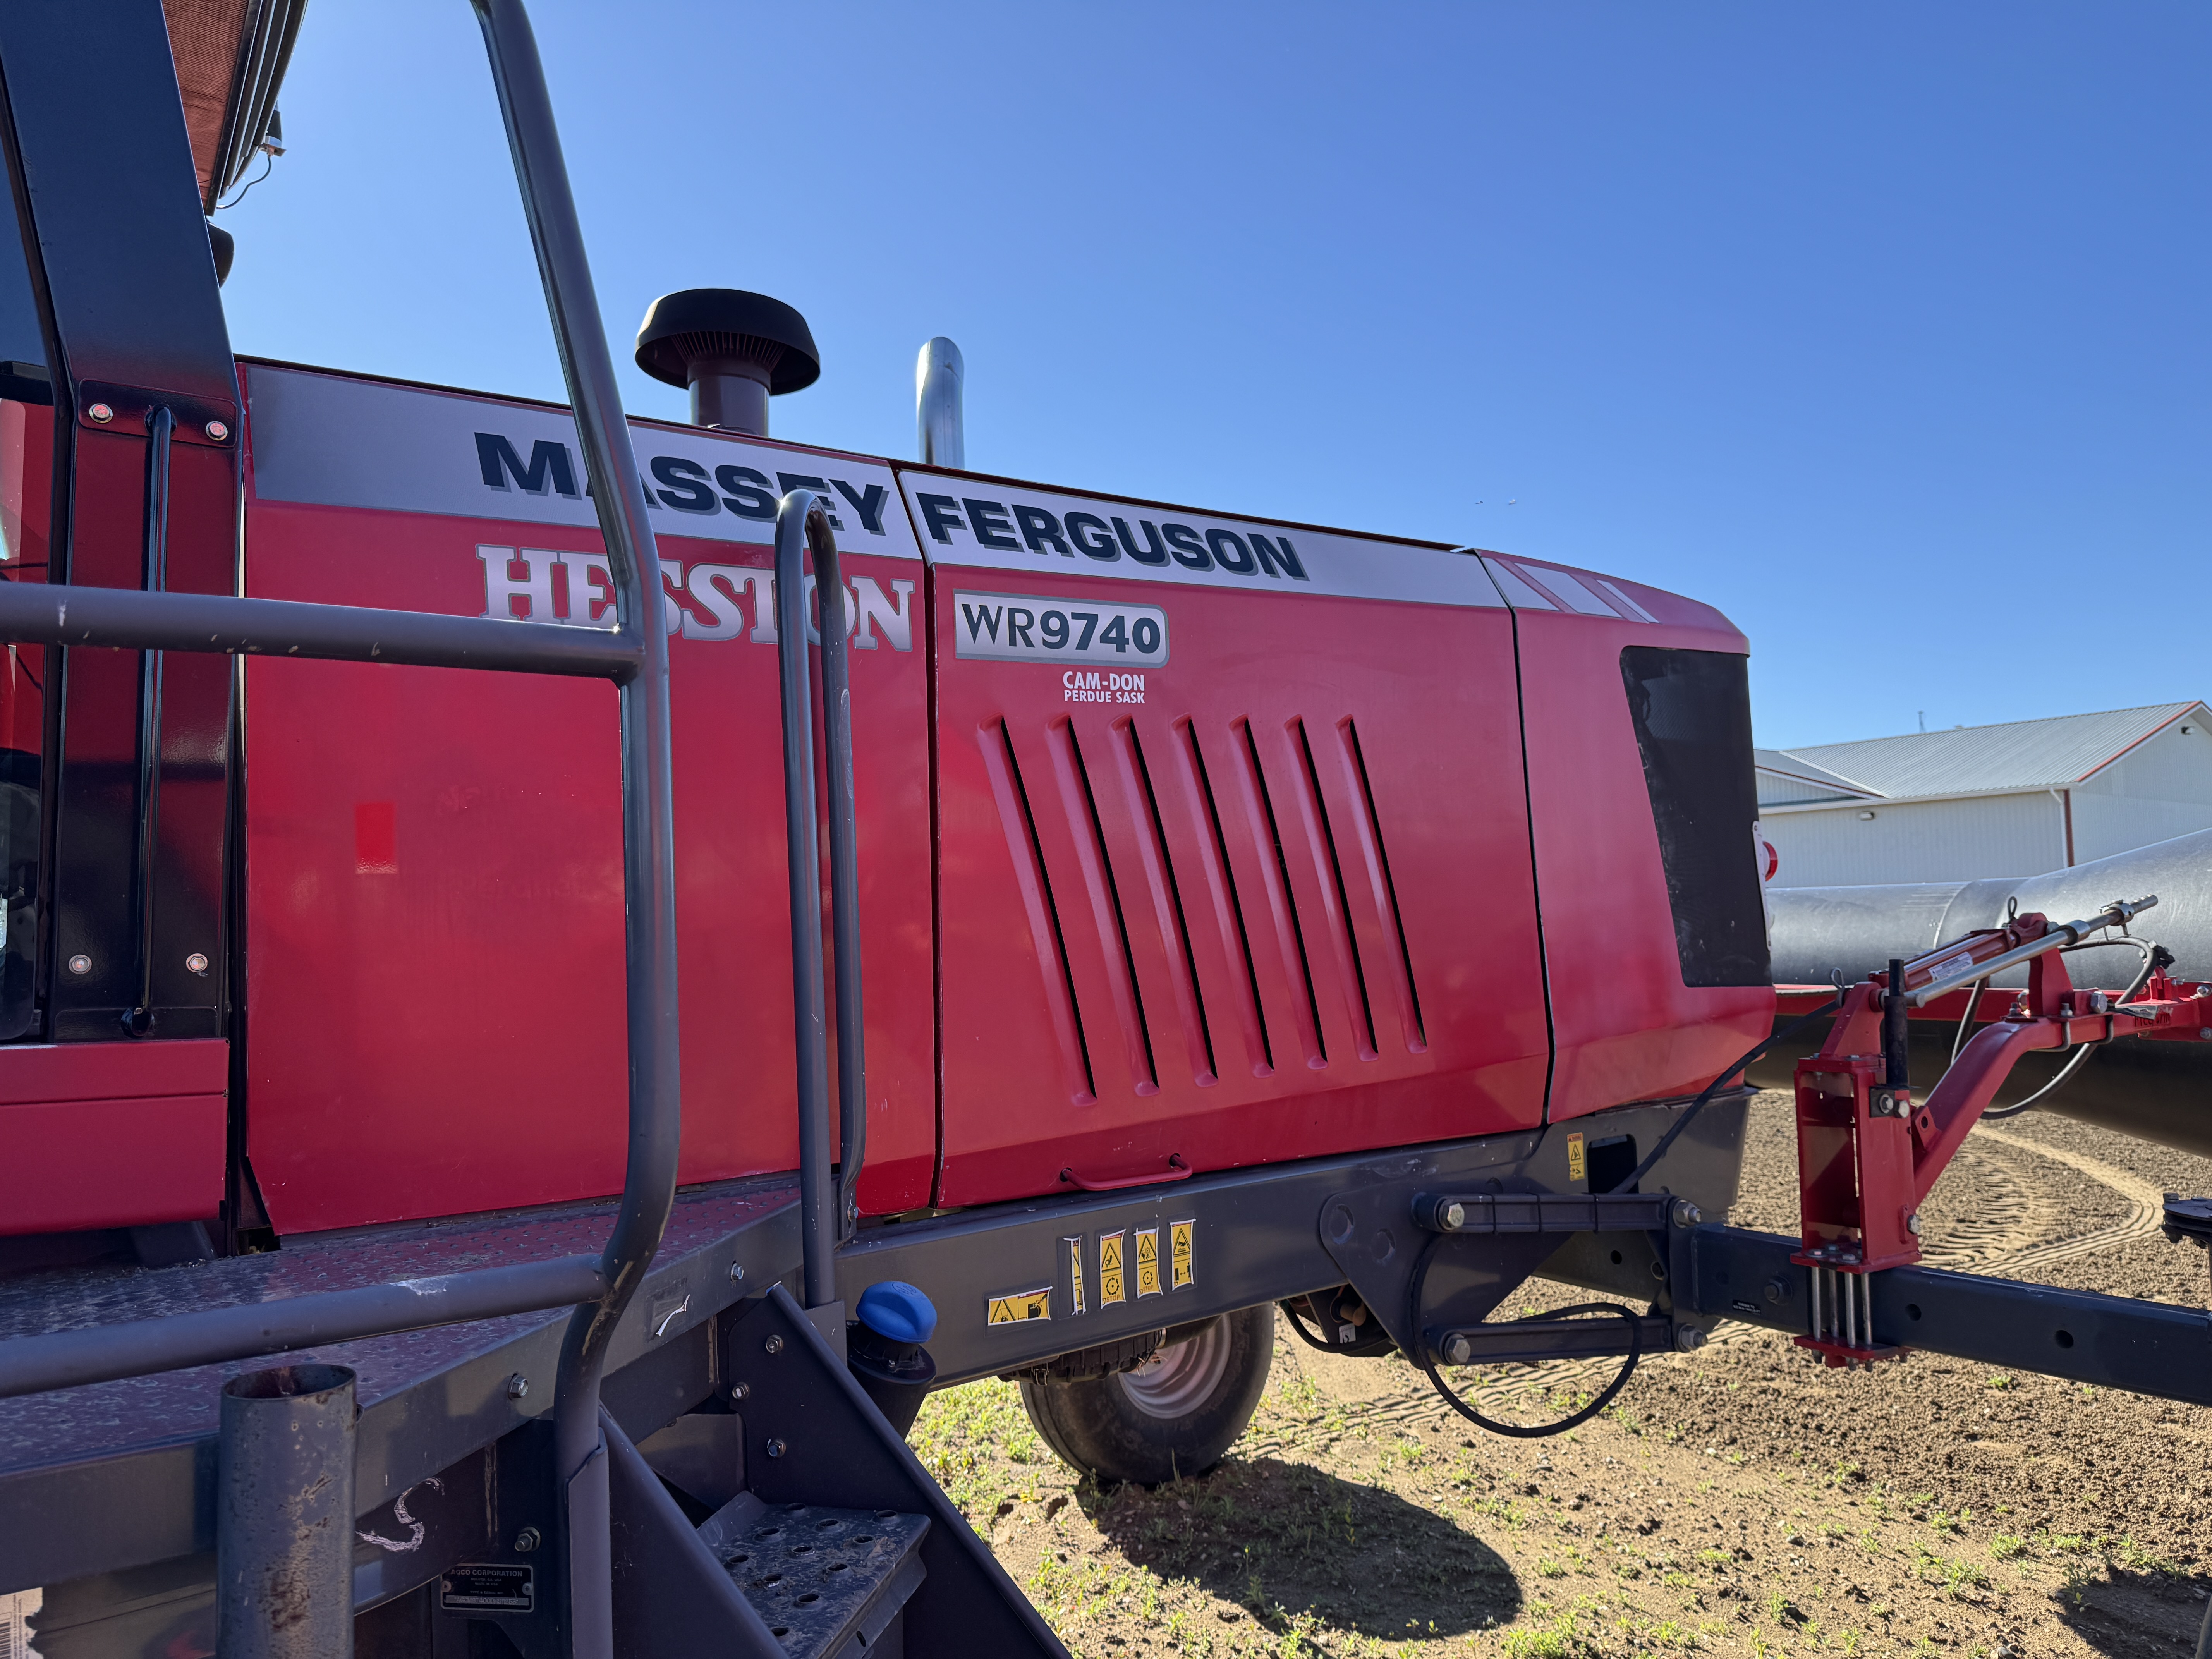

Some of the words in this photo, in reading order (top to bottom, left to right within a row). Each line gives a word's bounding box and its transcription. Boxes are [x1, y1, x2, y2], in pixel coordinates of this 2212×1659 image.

[475, 432, 889, 536] MSSEY
[915, 492, 1310, 581] FERGUSON
[962, 603, 1161, 654] WR9740
[1063, 671, 1145, 691] CAM-DON
[1064, 690, 1111, 703] PERDUE
[1116, 692, 1145, 704] SASK
[1106, 1294, 1120, 1303] STOP
